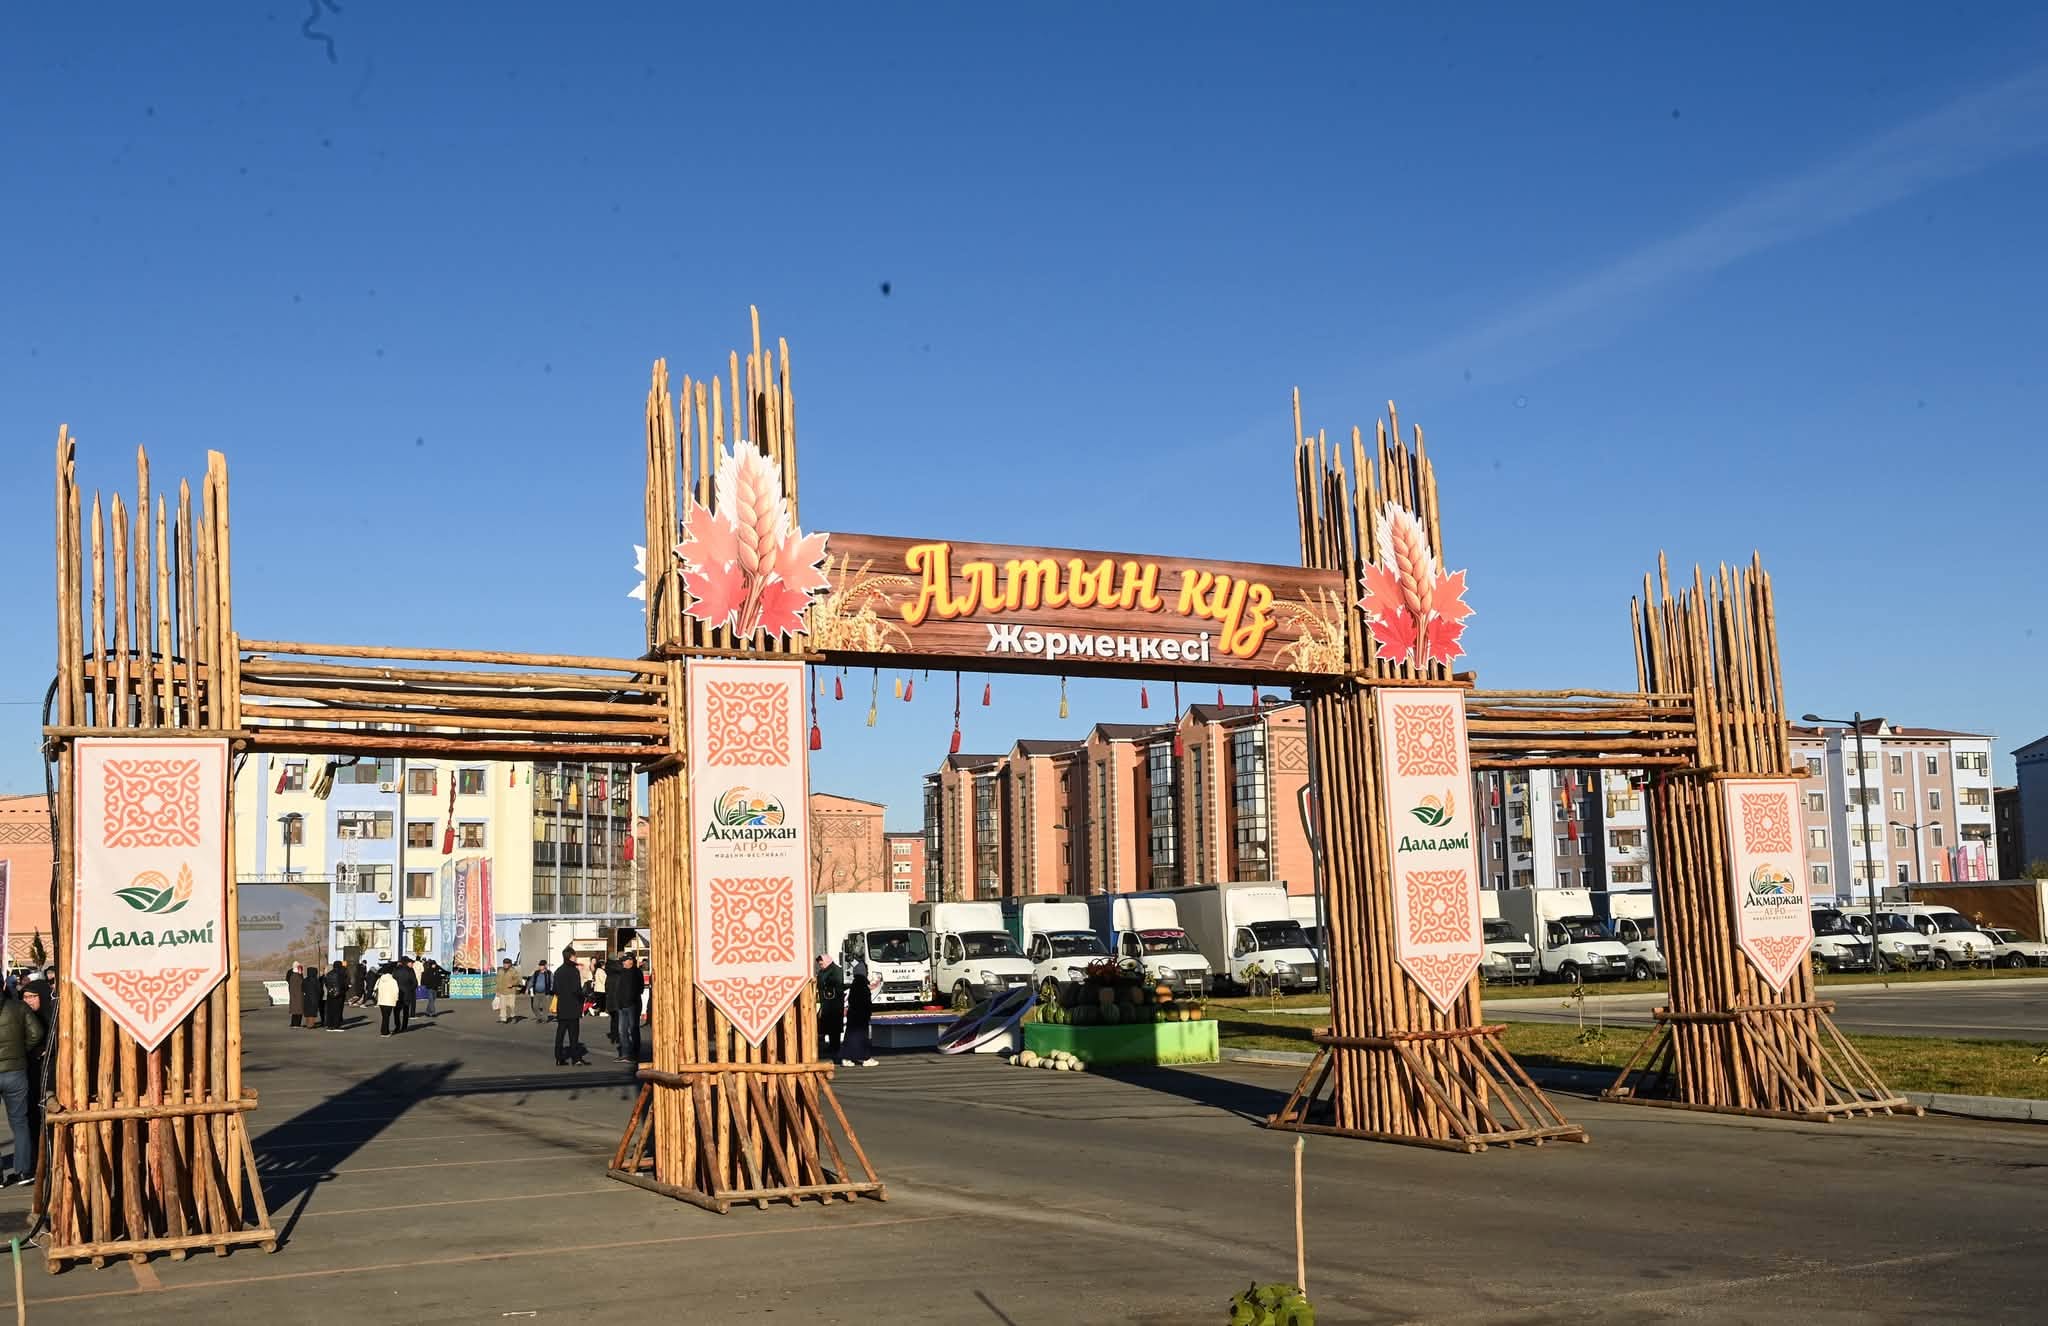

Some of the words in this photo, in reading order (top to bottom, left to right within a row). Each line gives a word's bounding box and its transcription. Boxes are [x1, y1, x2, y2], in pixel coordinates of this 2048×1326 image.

[902, 543, 1165, 626] Алтын
[985, 622, 1211, 663] Жәрмеңкесі
[702, 821, 797, 842] Ақмаржан
[1398, 836, 1437, 853] Дала
[1438, 832, 1469, 851] дәмі
[733, 842, 768, 851] АГРО
[88, 926, 155, 950] Дала
[158, 919, 214, 948] дәмі
